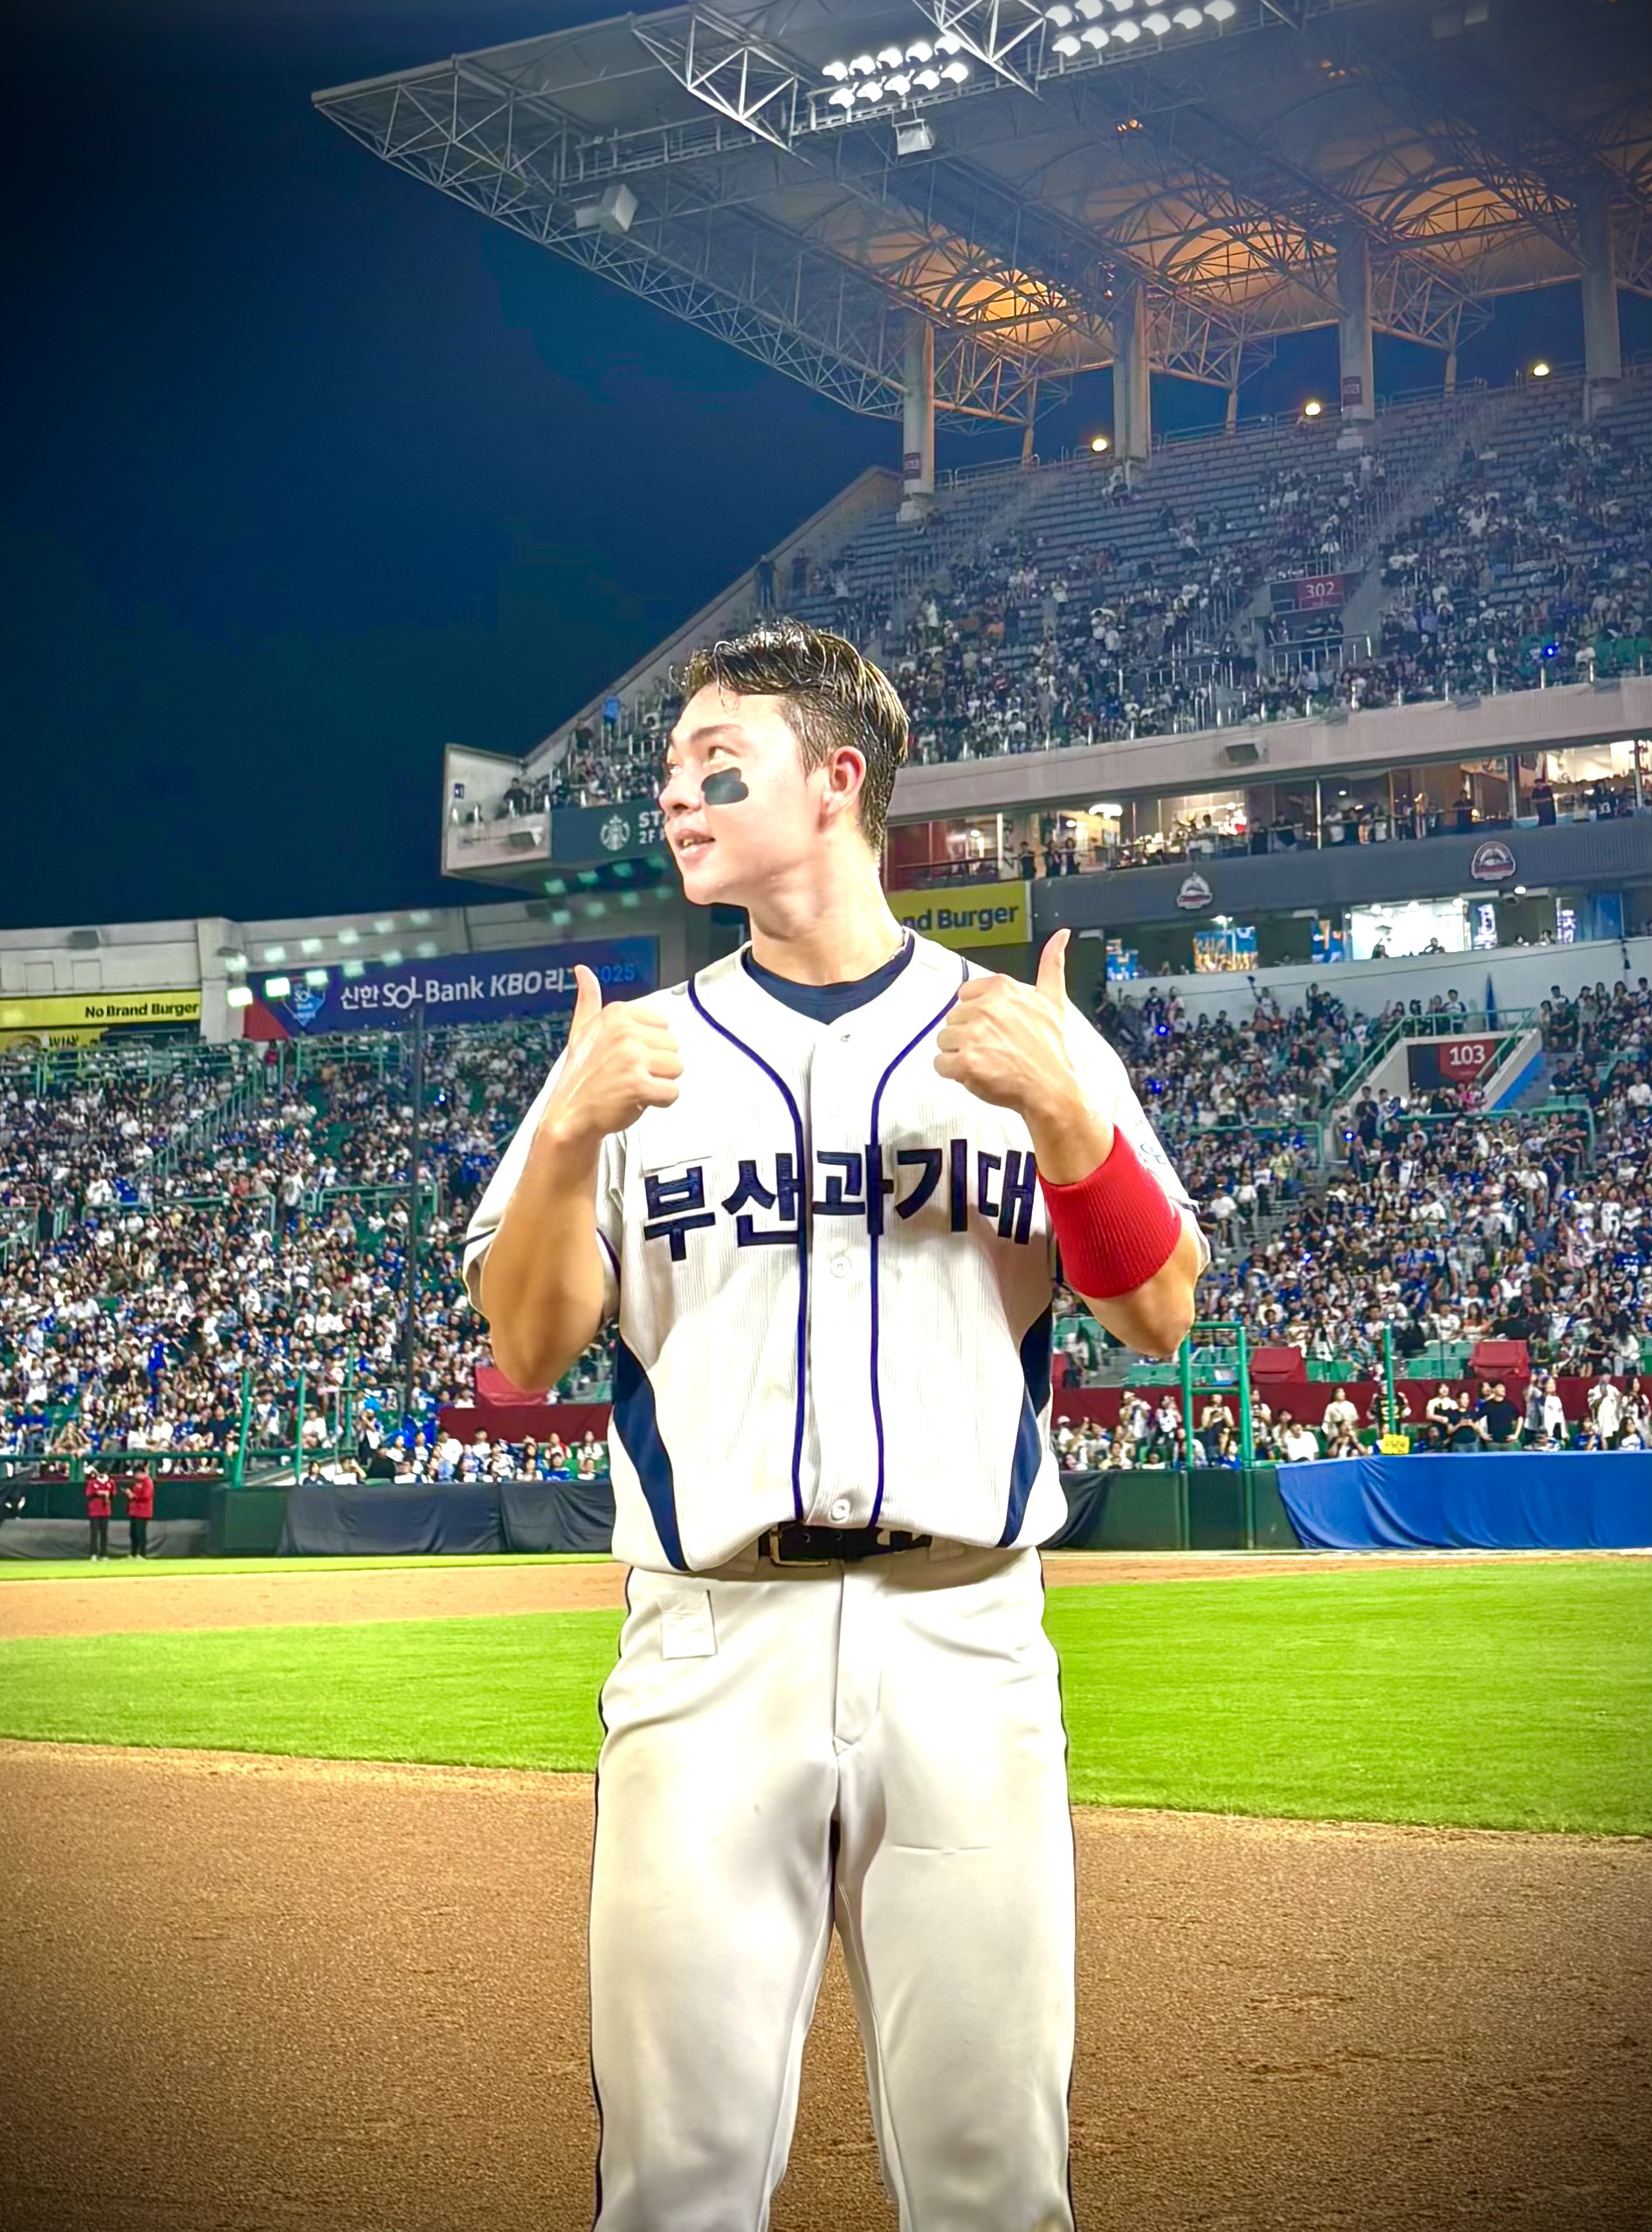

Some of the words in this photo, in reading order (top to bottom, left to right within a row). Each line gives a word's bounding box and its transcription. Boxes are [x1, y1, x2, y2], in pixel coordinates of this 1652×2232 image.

[1305, 582, 1335, 598] 302
[937, 905, 1019, 932] Burger
[341, 984, 380, 1010] 신한
[382, 975, 423, 1009] SOL
[425, 975, 485, 1003] Bank
[595, 963, 636, 984] 025
[85, 1006, 105, 1018] No
[107, 1003, 148, 1016] Brand
[151, 1002, 199, 1017] Burger
[1449, 1044, 1486, 1065] 103
[644, 1138, 1038, 1261] 부산과기대
